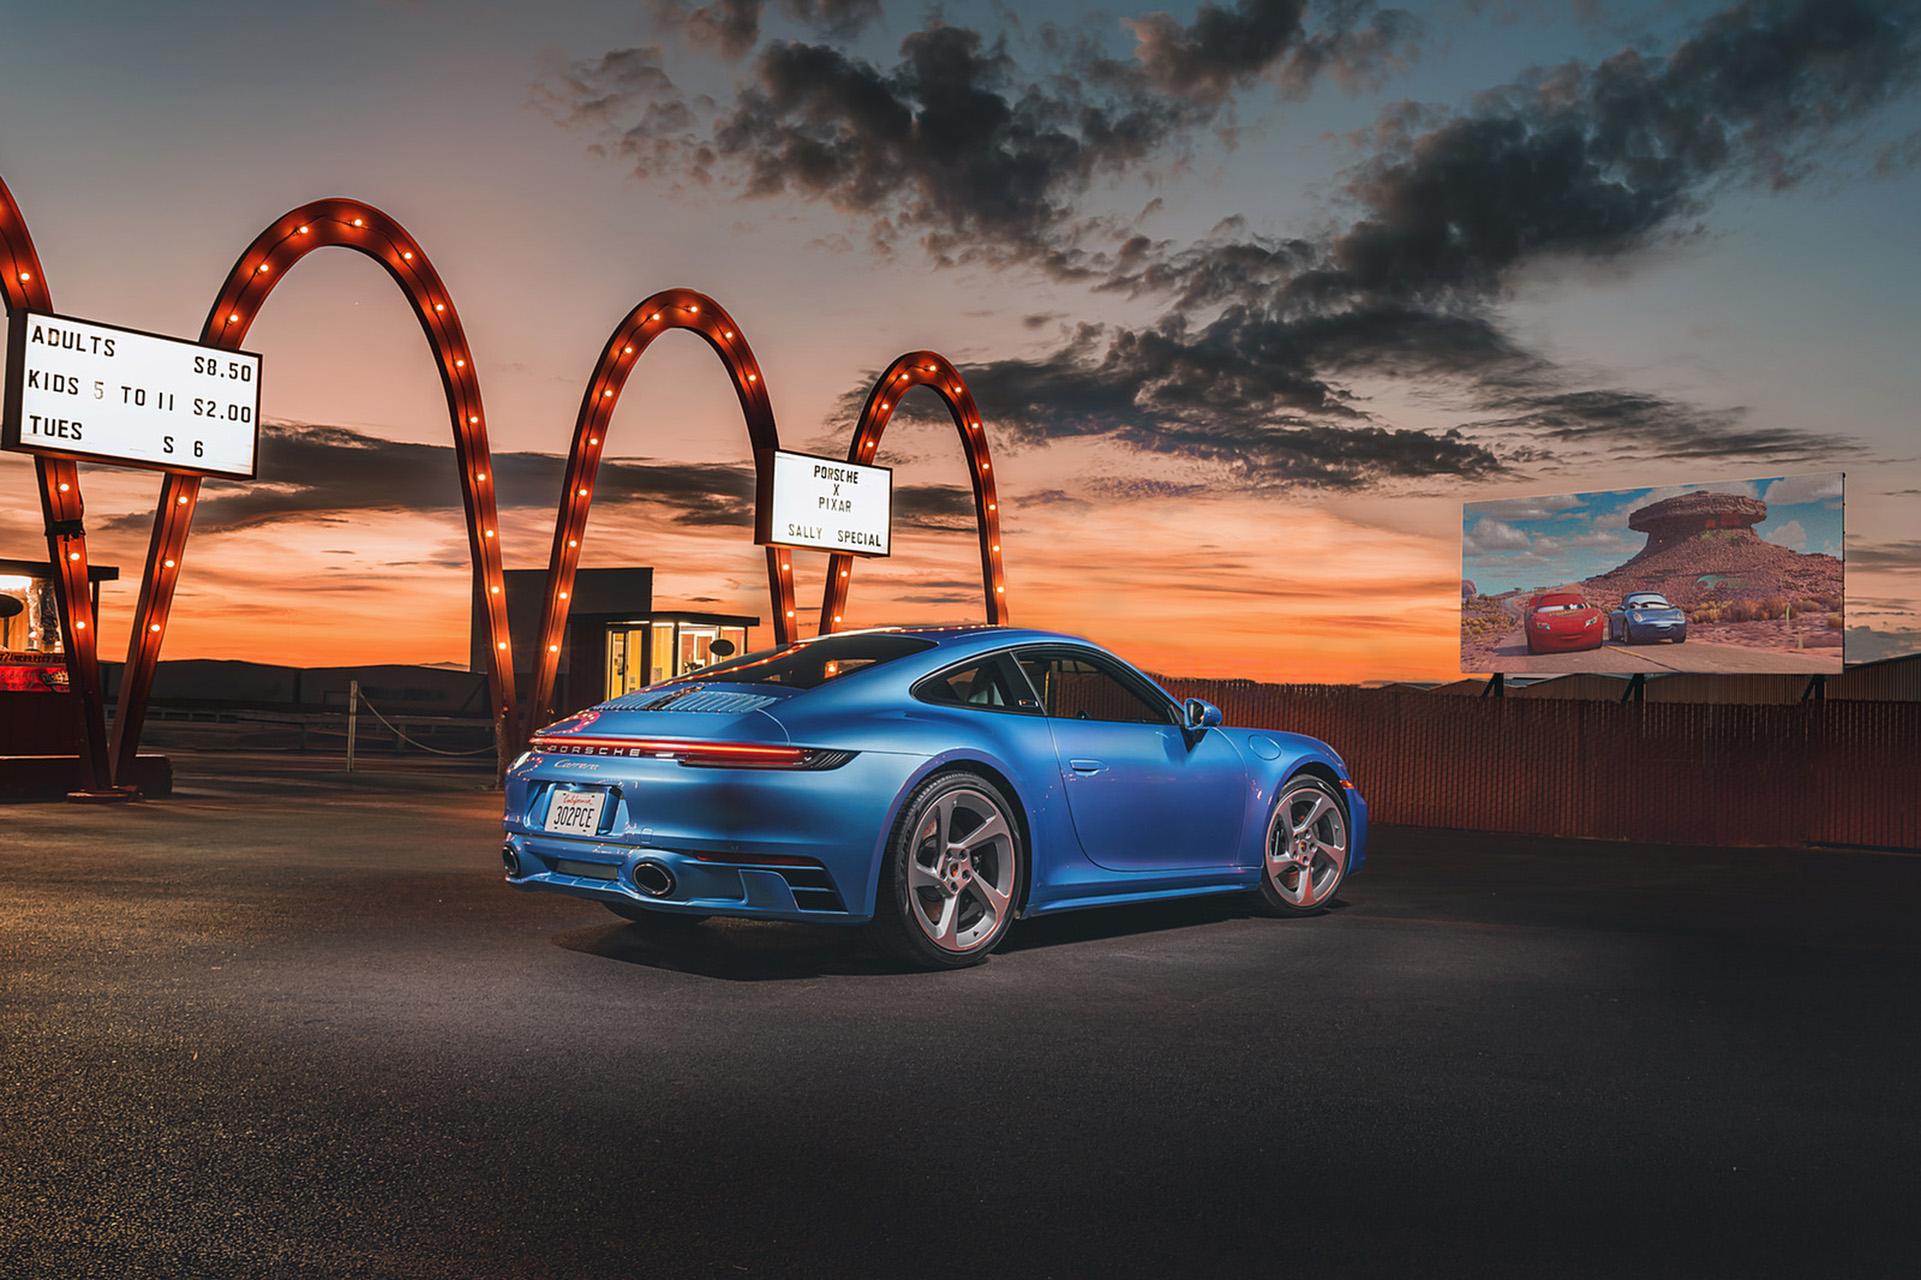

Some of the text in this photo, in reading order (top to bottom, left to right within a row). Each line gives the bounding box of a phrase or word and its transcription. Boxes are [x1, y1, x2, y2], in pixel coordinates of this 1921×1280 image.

[31, 325, 116, 357] ADULTS
[28, 369, 79, 395] KIDS
[93, 381, 104, 399] 5
[121, 386, 146, 406] TO
[29, 415, 83, 440] TUES
[194, 441, 204, 458] 6
[814, 465, 858, 484] PORSCHE
[832, 484, 840, 496] X
[818, 497, 852, 512] PIXAR
[788, 523, 882, 547] SALLY SPECIAL
[549, 745, 641, 757] PORSCHE
[554, 759, 600, 771] Carrera
[563, 794, 593, 805] California
[553, 806, 595, 828] 302PCE
